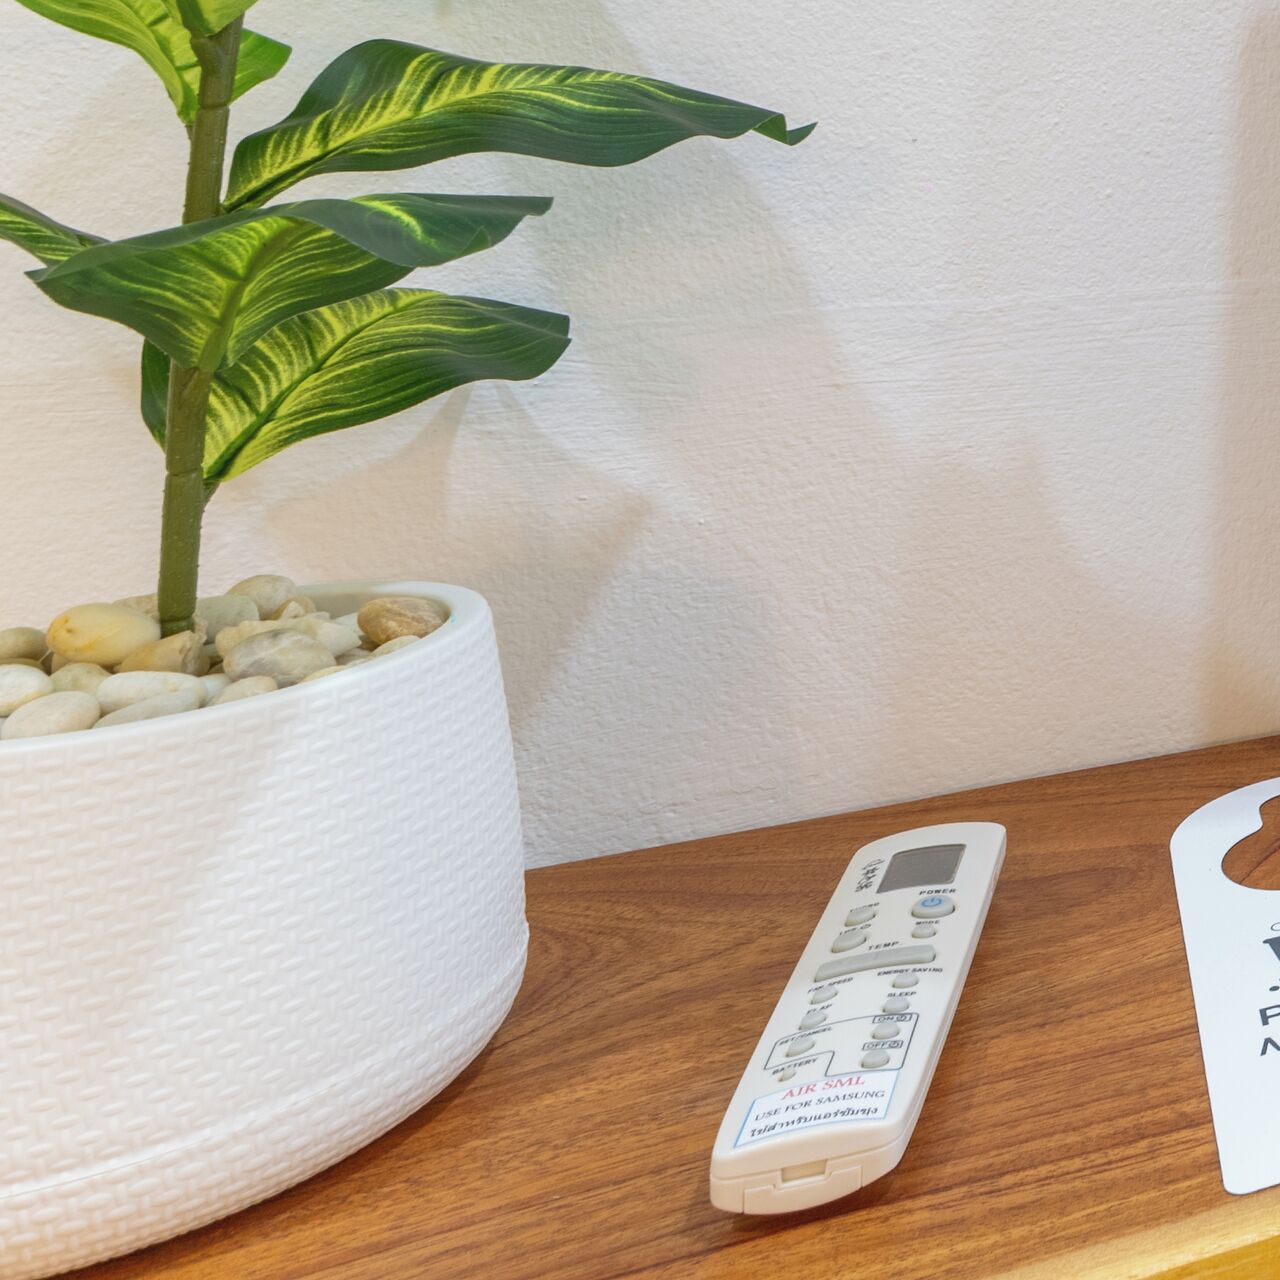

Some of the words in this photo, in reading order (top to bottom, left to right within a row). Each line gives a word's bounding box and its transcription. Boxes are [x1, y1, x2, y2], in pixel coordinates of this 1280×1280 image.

[919, 888, 957, 896] POWER
[866, 1041, 888, 1049] OFF
[781, 1084, 817, 1101] AIR
[822, 1076, 866, 1092] SML
[754, 1107, 782, 1121] USE
[784, 1099, 812, 1113] FOR
[815, 1090, 886, 1105] SAMSUNG
